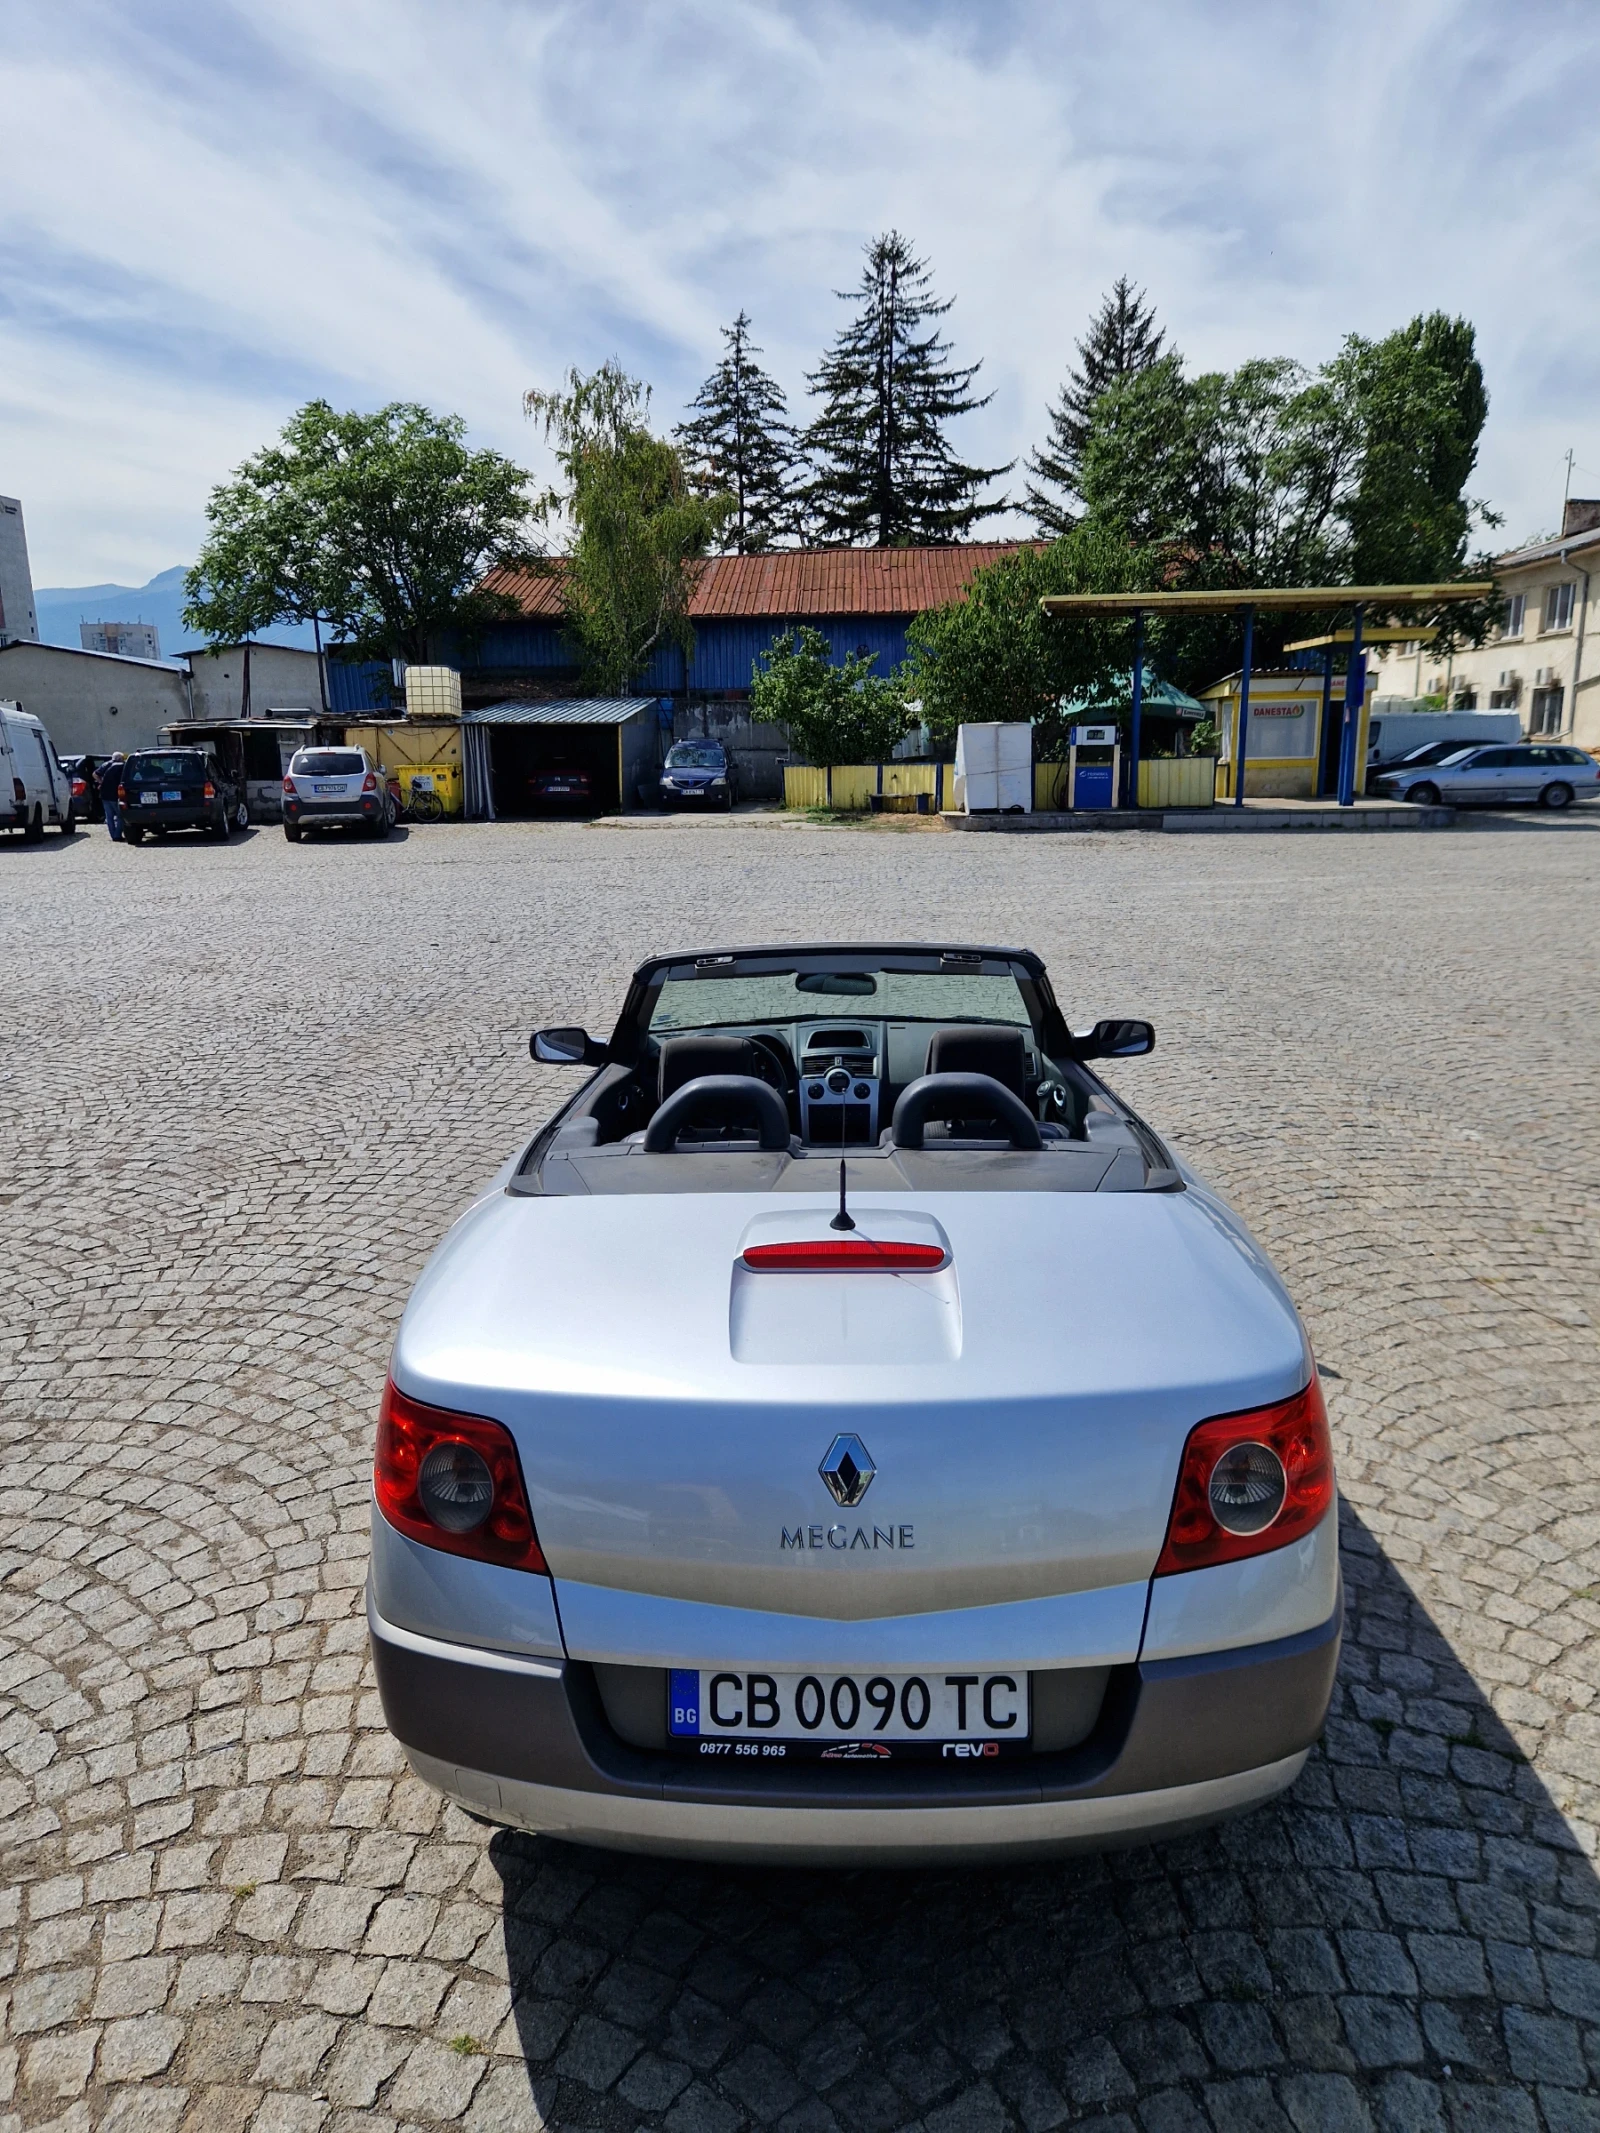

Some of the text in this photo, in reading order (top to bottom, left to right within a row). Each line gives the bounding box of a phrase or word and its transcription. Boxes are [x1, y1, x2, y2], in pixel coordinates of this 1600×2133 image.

[1253, 707, 1292, 716] DANESTA
[780, 1525, 915, 1550] MEGANE
[710, 1673, 1017, 1730] CB 0090 TC
[674, 1708, 697, 1723] BG
[700, 1743, 786, 1756] 0877 556 965
